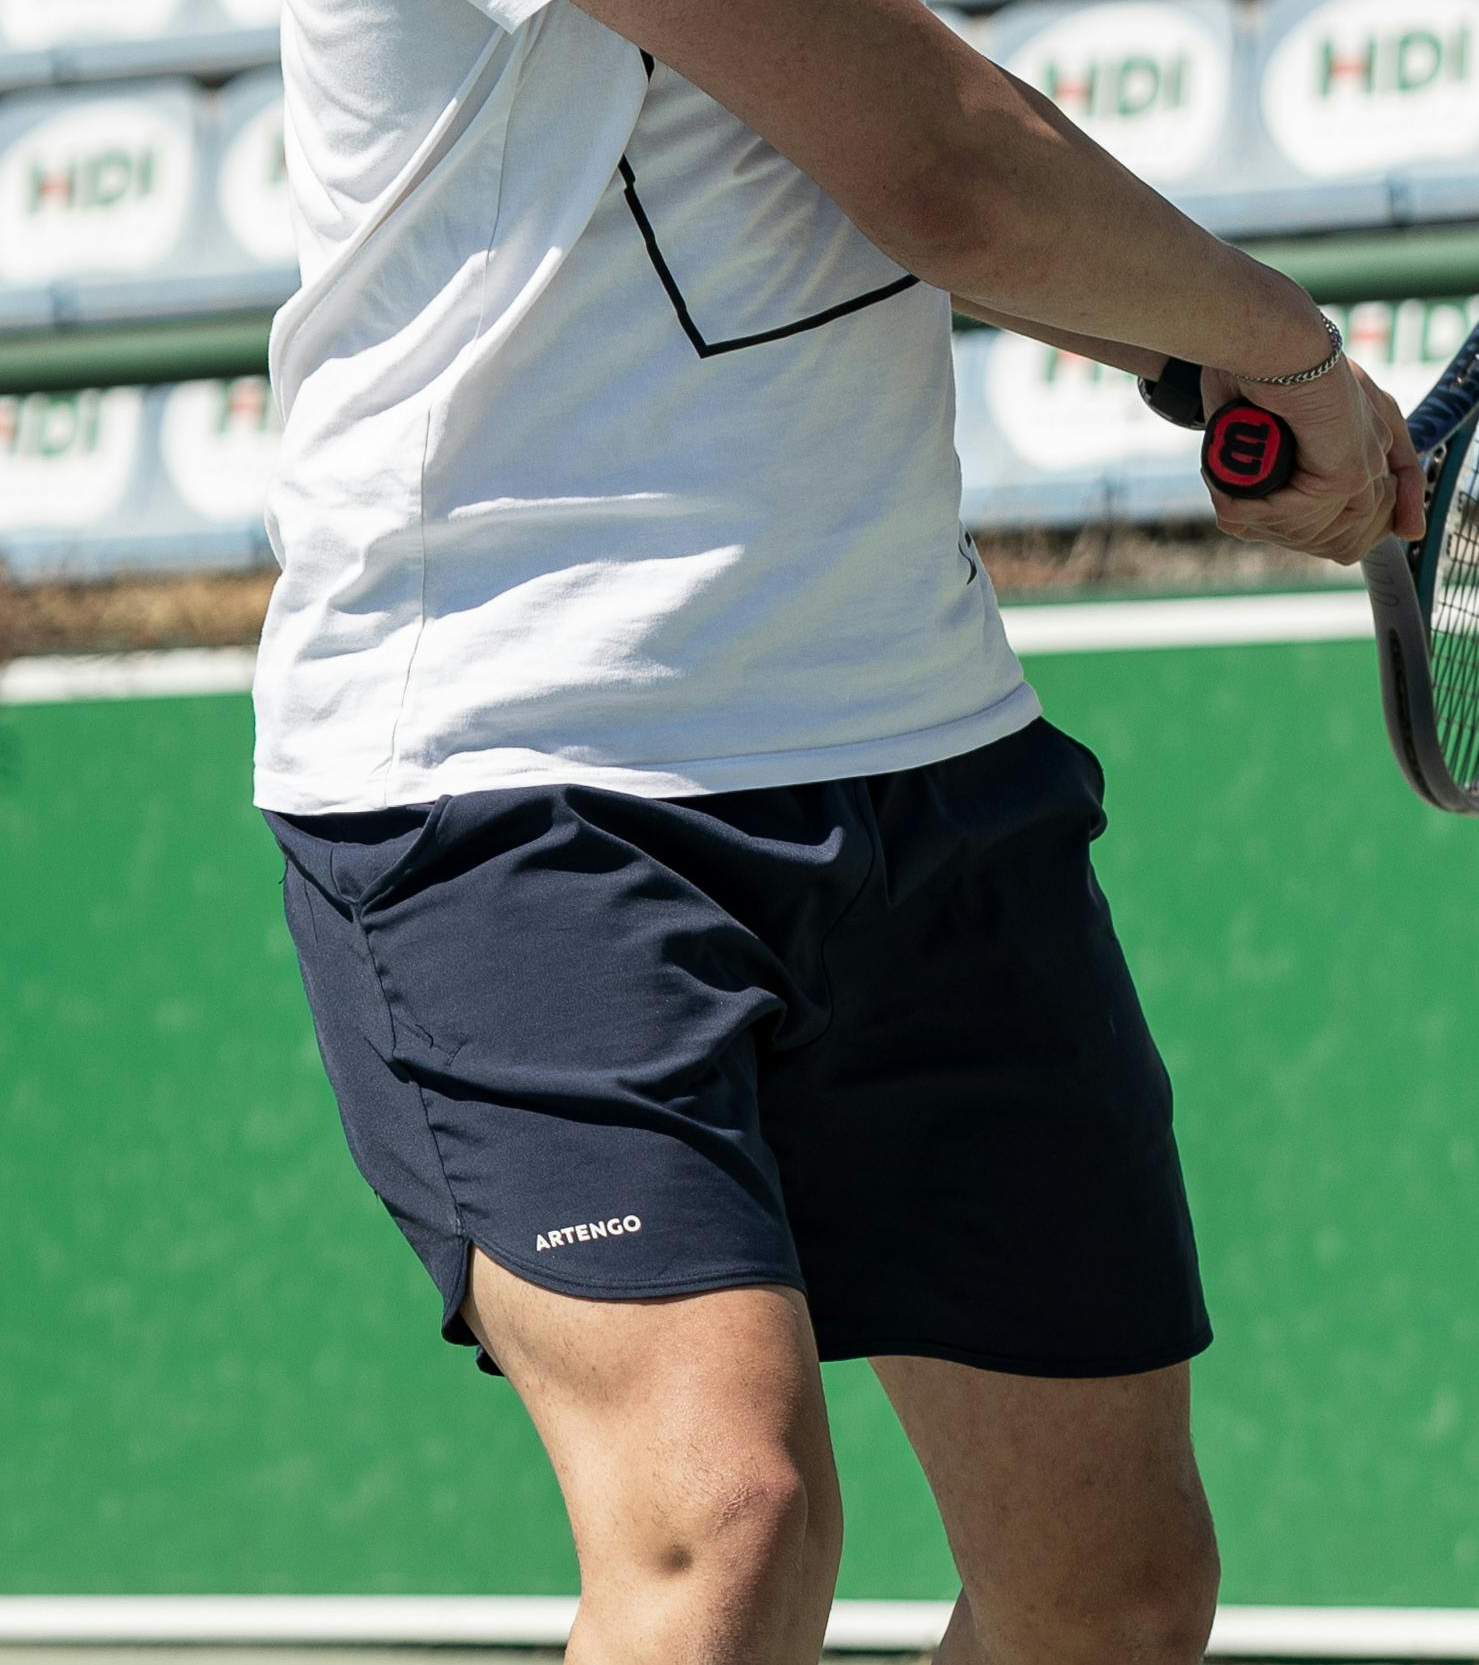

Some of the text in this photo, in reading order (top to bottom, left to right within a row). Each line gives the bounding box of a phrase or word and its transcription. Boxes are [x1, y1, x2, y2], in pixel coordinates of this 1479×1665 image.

[1039, 54, 1188, 119] HDI
[1318, 23, 1471, 100] HDI
[27, 151, 154, 214] HDI
[536, 1214, 641, 1251] ARTENGO
